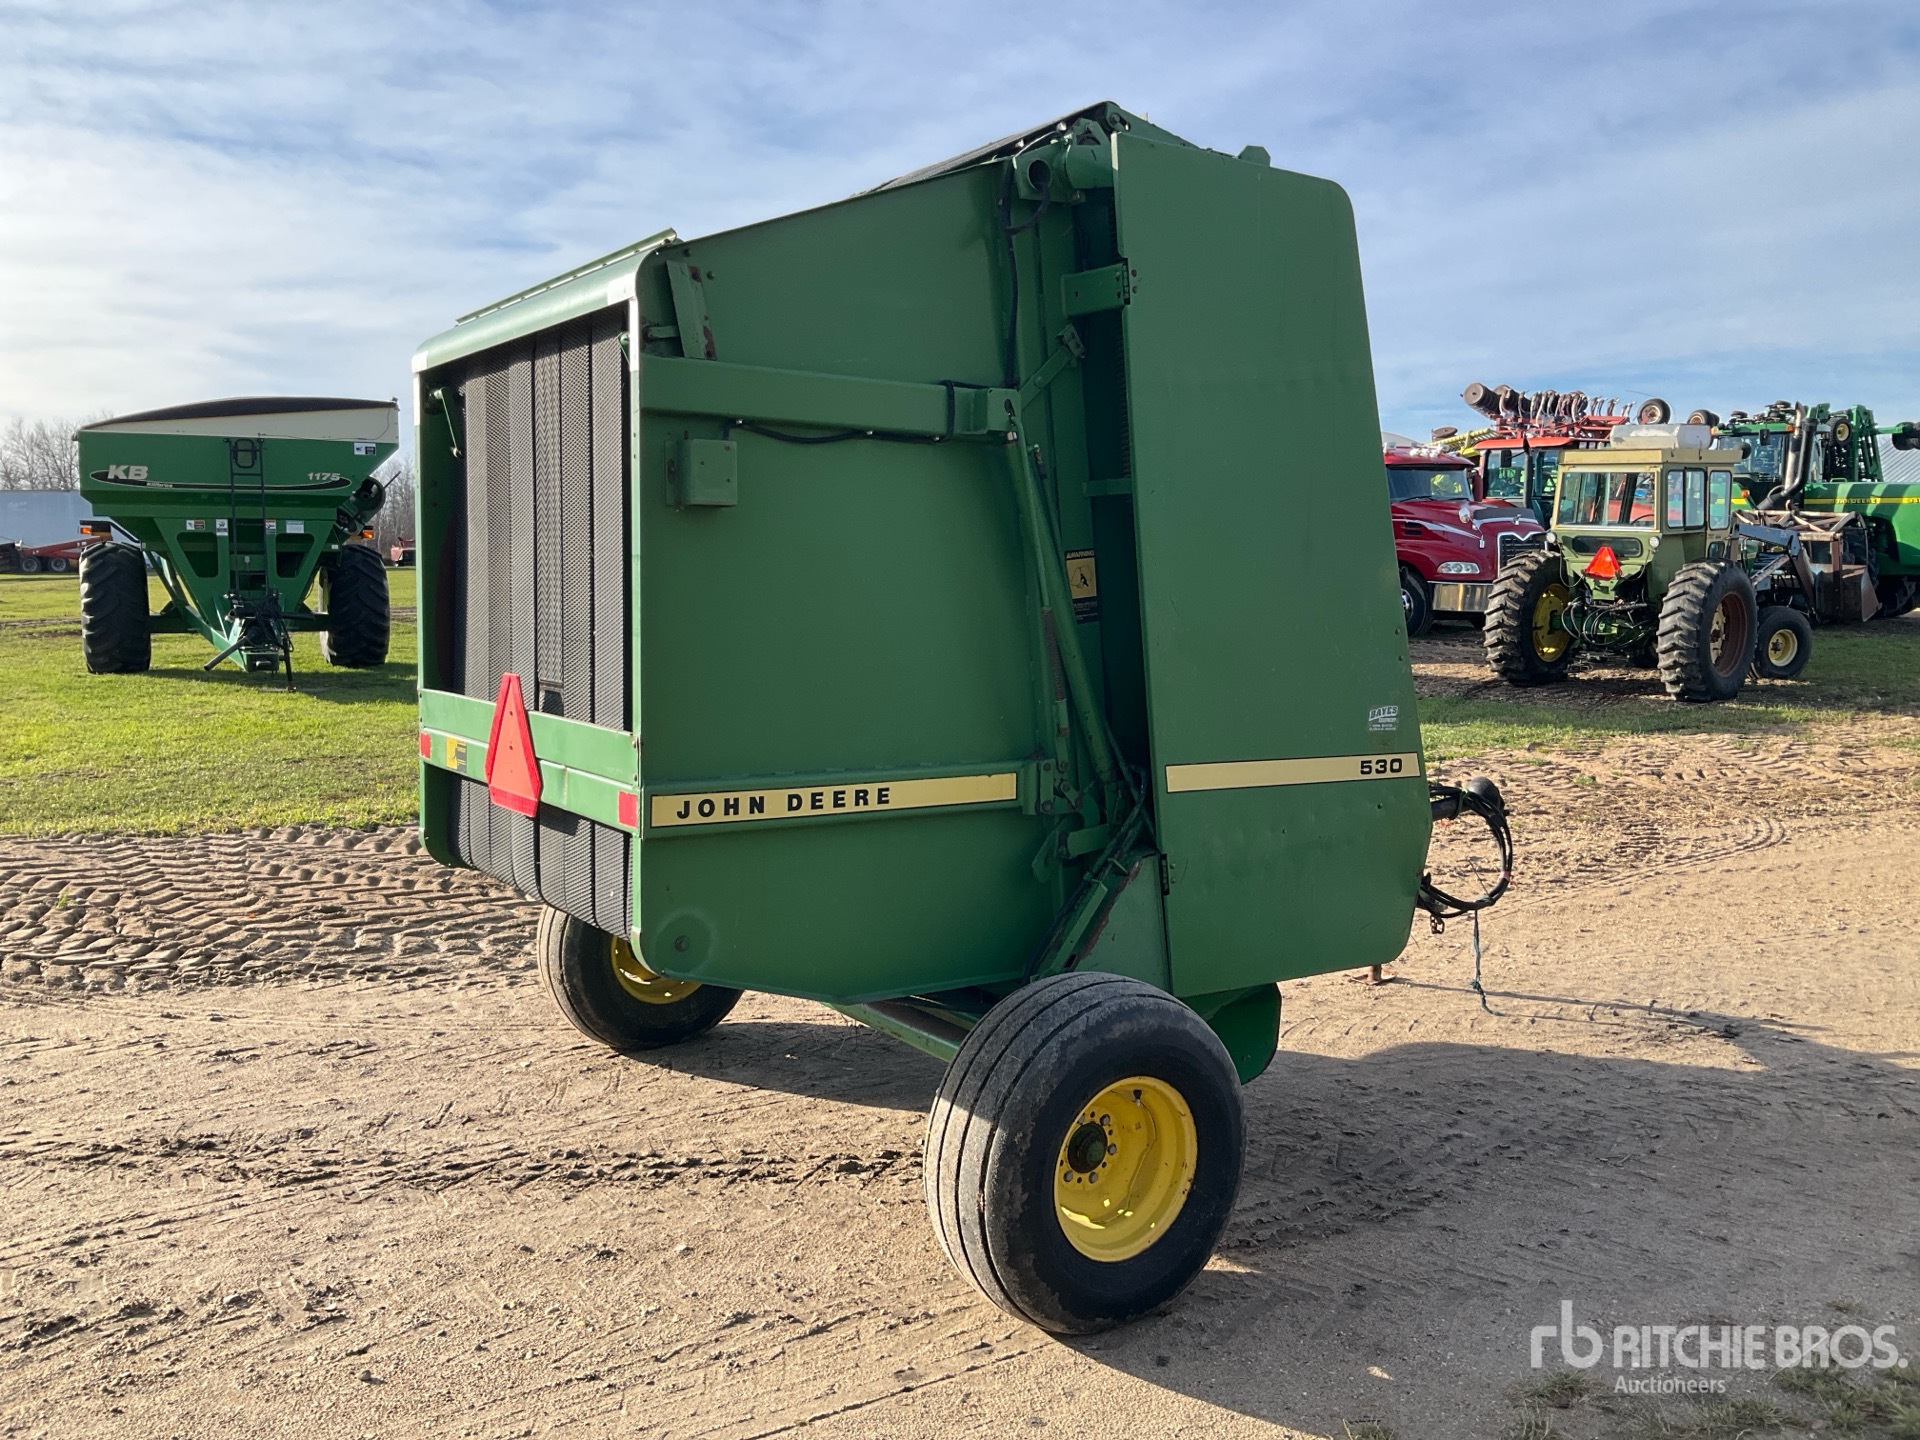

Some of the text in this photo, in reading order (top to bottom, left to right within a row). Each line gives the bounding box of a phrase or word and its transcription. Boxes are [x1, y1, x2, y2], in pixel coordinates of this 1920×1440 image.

[107, 464, 149, 480] KB
[307, 472, 341, 481] 1175
[1369, 706, 1398, 720] BAYES
[1360, 758, 1403, 775] 530
[676, 787, 891, 819] JOHN DEERE
